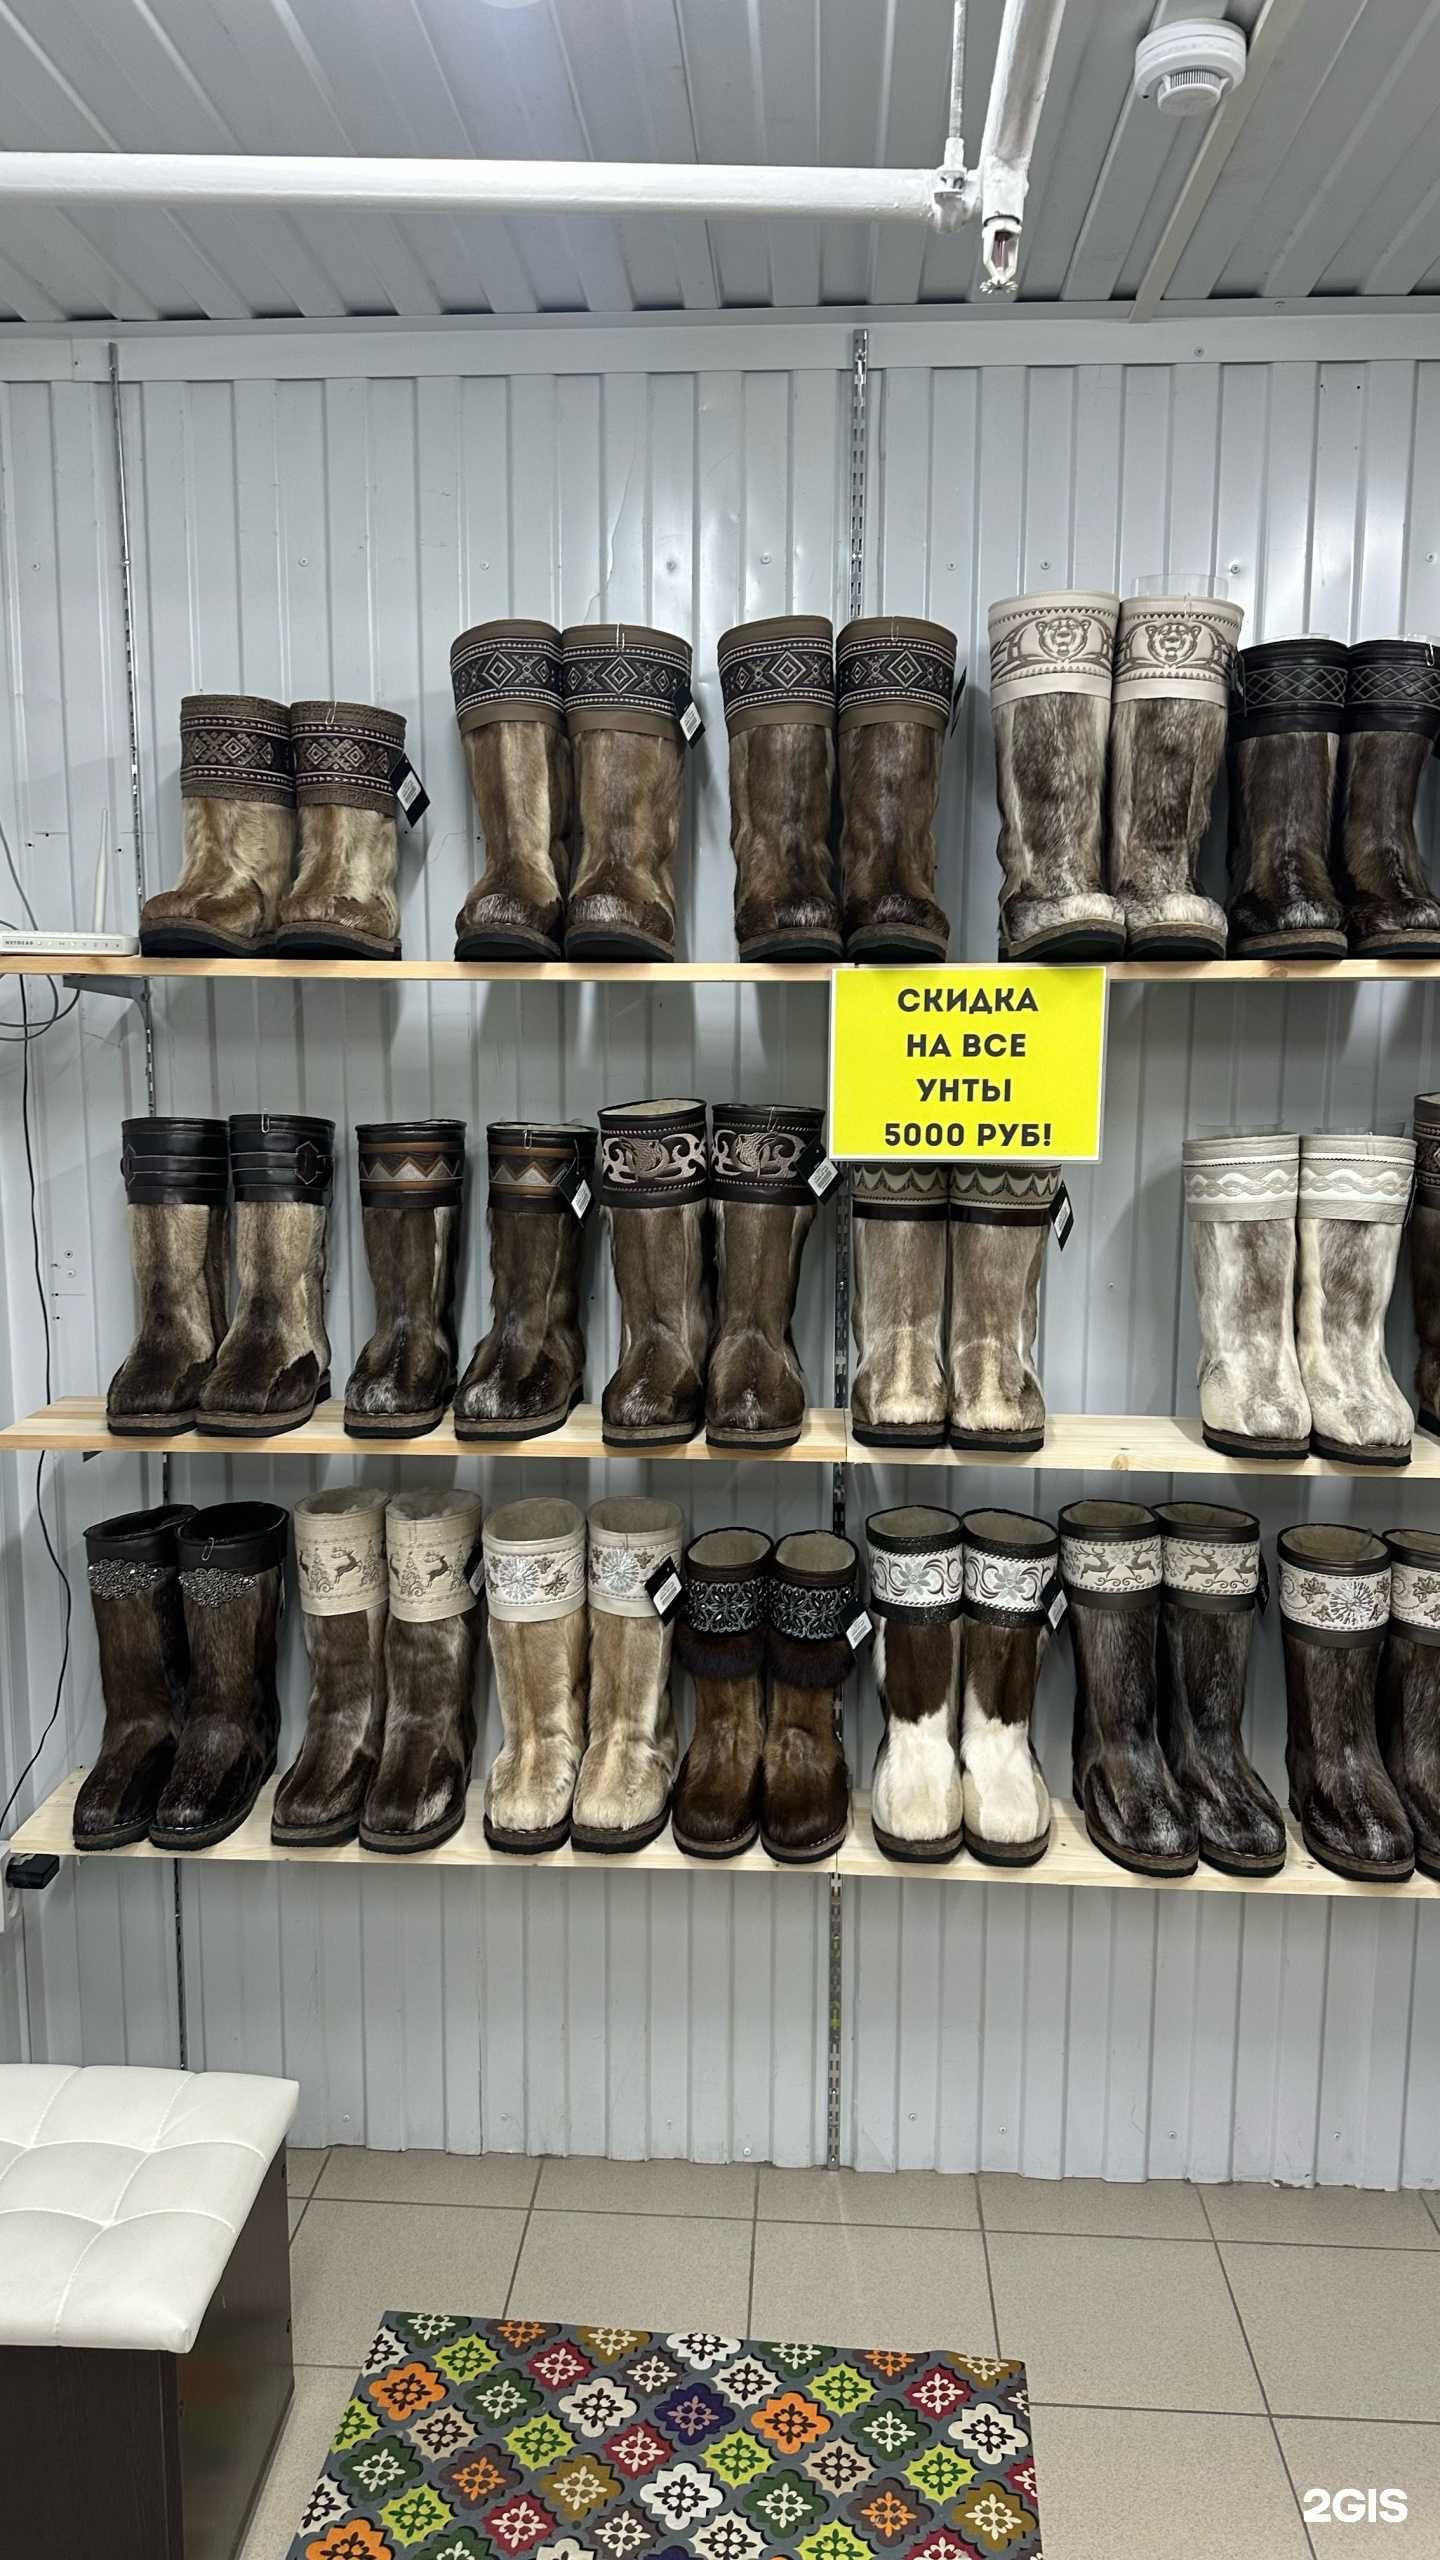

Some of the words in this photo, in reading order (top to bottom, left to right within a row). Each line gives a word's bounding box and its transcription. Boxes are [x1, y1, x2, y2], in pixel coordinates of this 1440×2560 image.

[897, 987, 1039, 1014] СКИДКА
[906, 1033, 951, 1057] НА
[962, 1033, 1026, 1057] ВСЕ
[916, 1078, 1012, 1102] УНТЫ
[884, 1122, 965, 1147] 5000
[977, 1123, 1052, 1147] РУБ!
